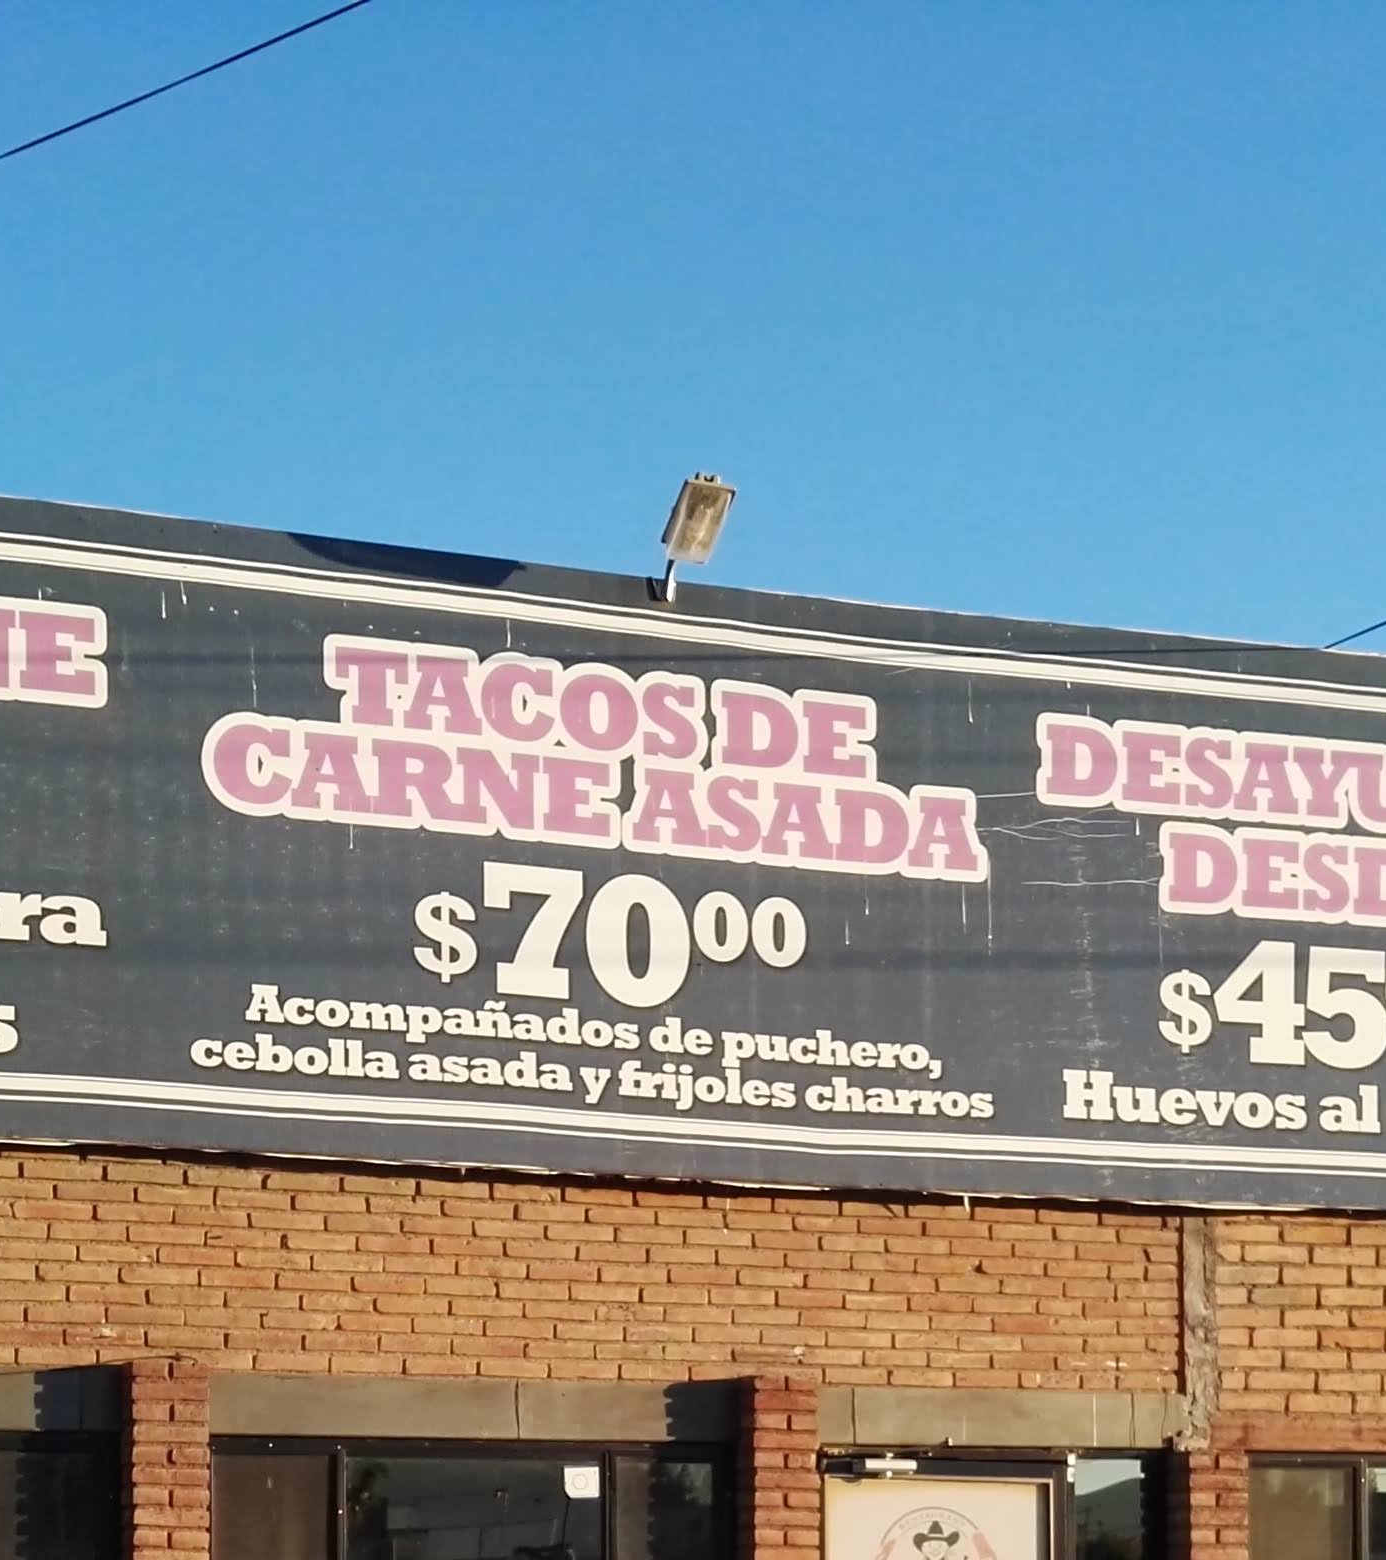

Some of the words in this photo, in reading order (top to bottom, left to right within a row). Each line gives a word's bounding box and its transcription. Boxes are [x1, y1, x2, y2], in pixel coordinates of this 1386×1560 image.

[324, 635, 705, 764] TACOS
[711, 680, 876, 782] DE
[203, 712, 620, 848] CARNE
[624, 763, 988, 882] ASADA
[189, 1033, 400, 1080] cebolla
[407, 1049, 573, 1093] asada
[580, 1068, 613, 1106] y
[617, 1060, 798, 1111] frijoles
[805, 1074, 995, 1120] charros
[246, 983, 640, 1052] Acompañados
[650, 1018, 712, 1057] de
[721, 1030, 943, 1081] puchero,
[1062, 1069, 1307, 1131] Huevos
[1318, 1084, 1381, 1134] al
